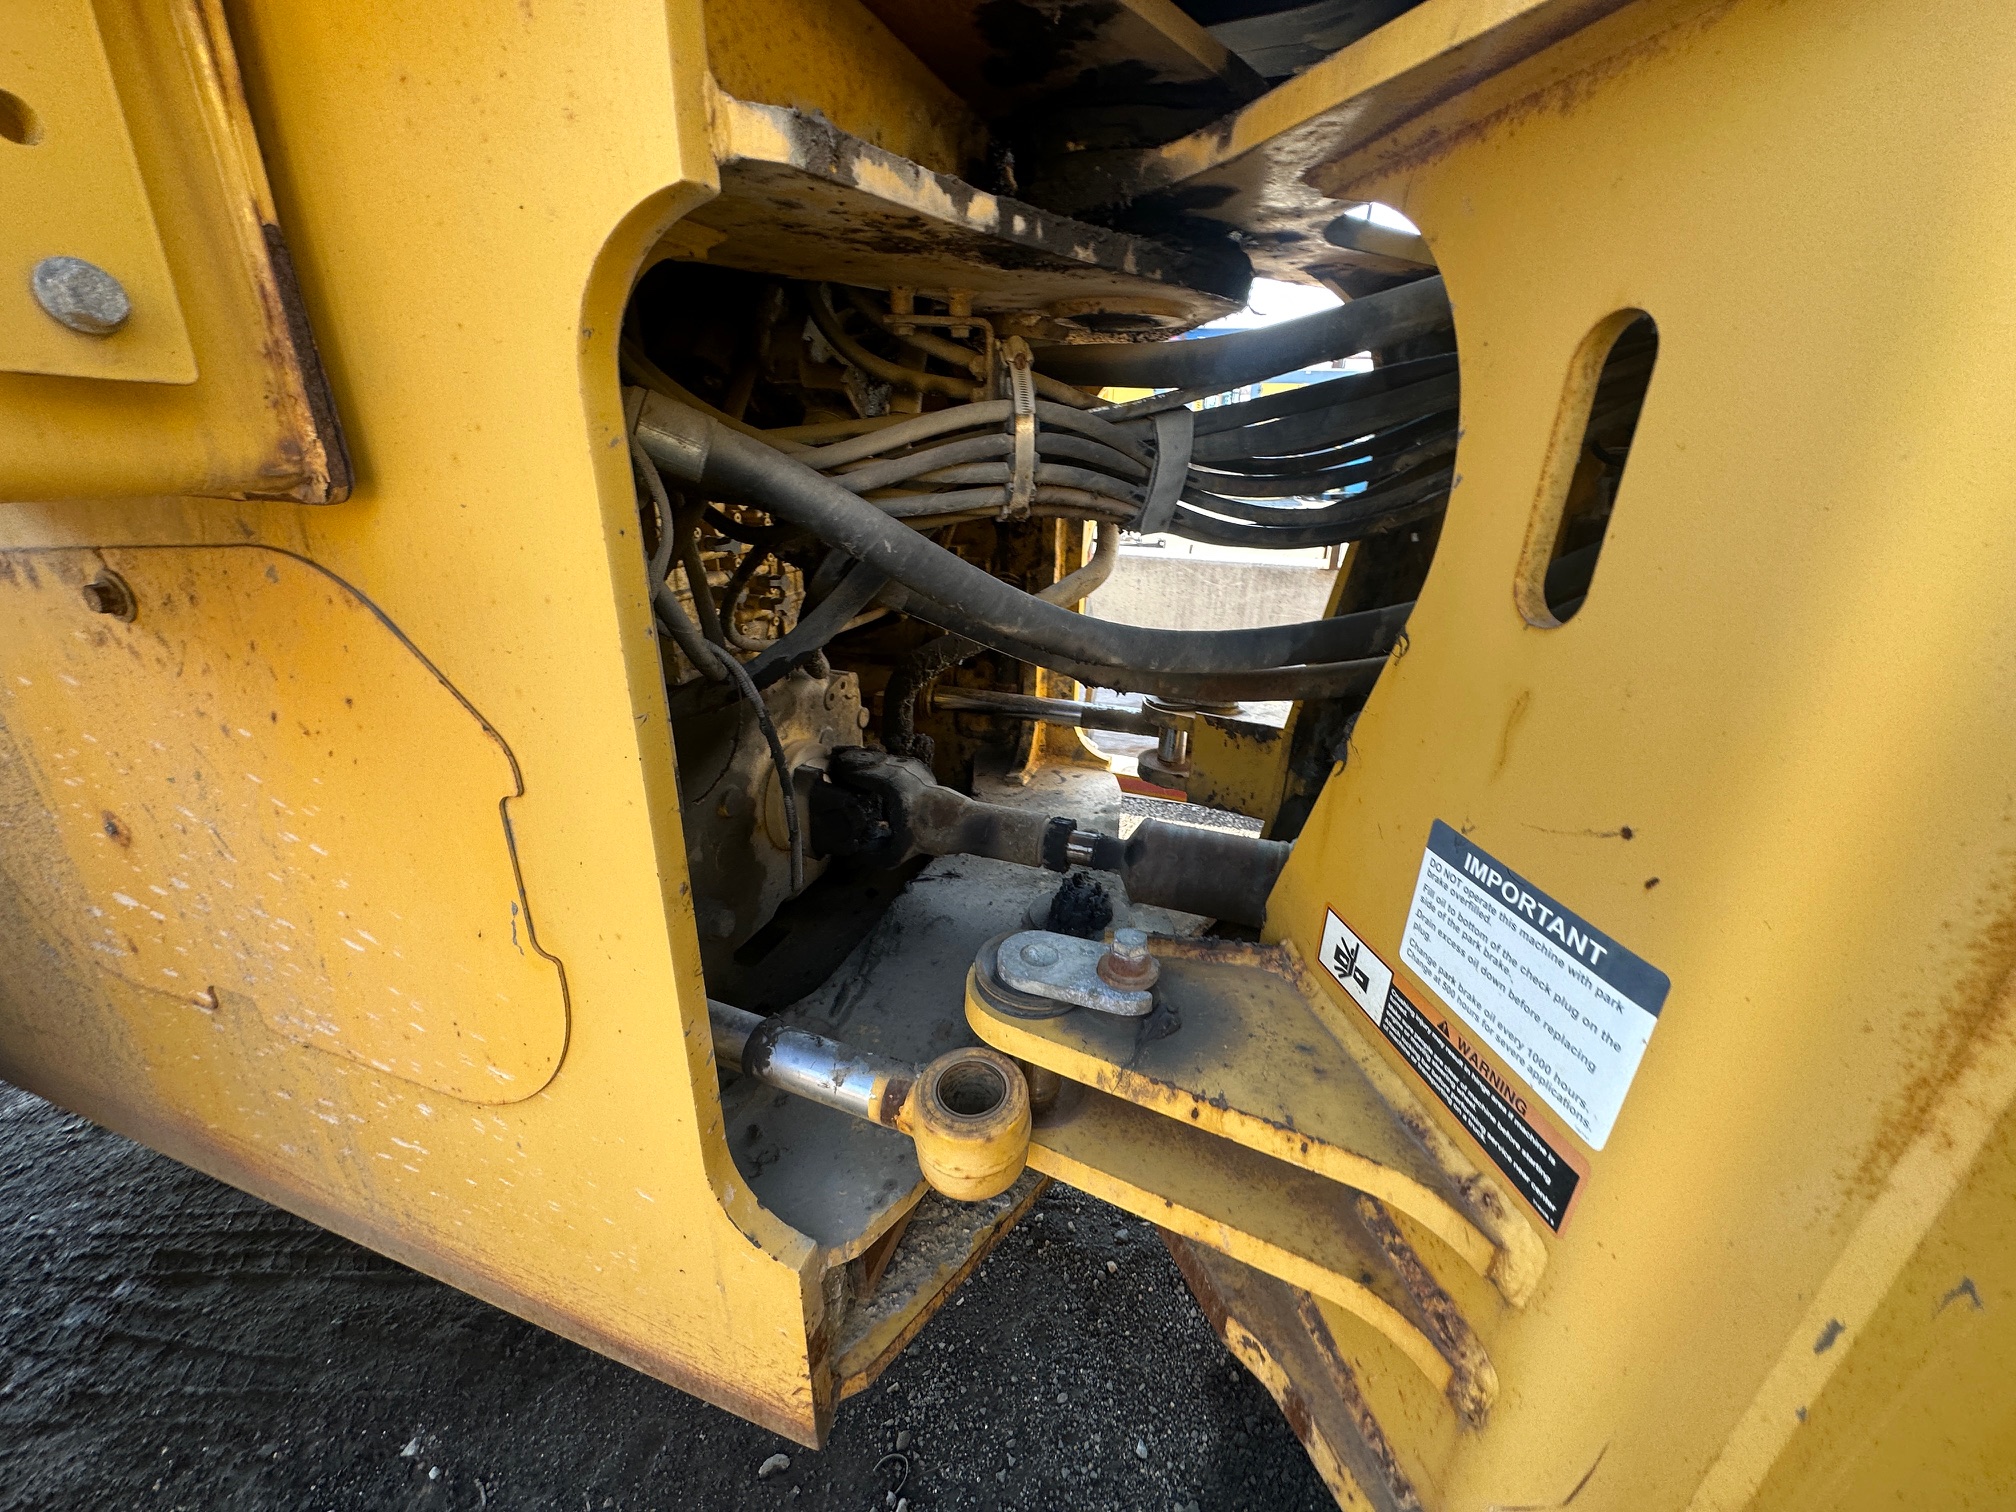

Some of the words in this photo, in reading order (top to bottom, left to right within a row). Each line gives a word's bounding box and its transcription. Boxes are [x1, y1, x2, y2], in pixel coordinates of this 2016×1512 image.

[1412, 921, 1431, 942] plug.
[1419, 895, 1436, 913] side
[1436, 910, 1447, 921] of
[1446, 917, 1460, 933] the
[1461, 930, 1481, 952] park
[1482, 946, 1511, 978] brake.
[1426, 867, 1448, 891] brake
[1449, 888, 1491, 926] overfilled.
[1429, 857, 1442, 873] DO
[1442, 867, 1462, 888] NOT
[1462, 885, 1497, 916] operate
[1498, 911, 1517, 932] this
[1518, 928, 1564, 968] machine
[1567, 964, 1592, 990] with
[1594, 986, 1624, 1014] park
[1463, 852, 1607, 965] IMPORTANT
[1409, 937, 1437, 968] Change
[1437, 965, 1456, 986] park
[1457, 981, 1482, 1010] brake
[1483, 1008, 1496, 1023] oil
[1496, 1021, 1524, 1050] every
[1527, 1047, 1551, 1075] 1000
[1553, 1071, 1588, 1113] hours.
[1415, 908, 1436, 931] Drain
[1437, 928, 1466, 957] excess
[1467, 955, 1479, 969] oil
[1480, 966, 1506, 993] down
[1507, 987, 1540, 1023] before
[1542, 1020, 1596, 1074] replacing
[1422, 882, 1435, 899] Fill
[1435, 895, 1446, 908] oil
[1447, 903, 1455, 916] to
[1457, 911, 1488, 943] bottom
[1489, 940, 1502, 953] of
[1501, 948, 1517, 967] the
[1519, 965, 1551, 996] check
[1552, 992, 1579, 1020] plug
[1581, 1016, 1597, 1034] on
[1600, 1029, 1621, 1052] the
[1406, 947, 1432, 977] Change
[1432, 974, 1441, 985] at
[1441, 980, 1455, 999] 500
[1456, 994, 1479, 1023] hours
[1481, 1018, 1494, 1035] for
[1494, 1033, 1525, 1066] severe
[1526, 1064, 1591, 1132] applications.
[1455, 1036, 1527, 1117] WARNING
